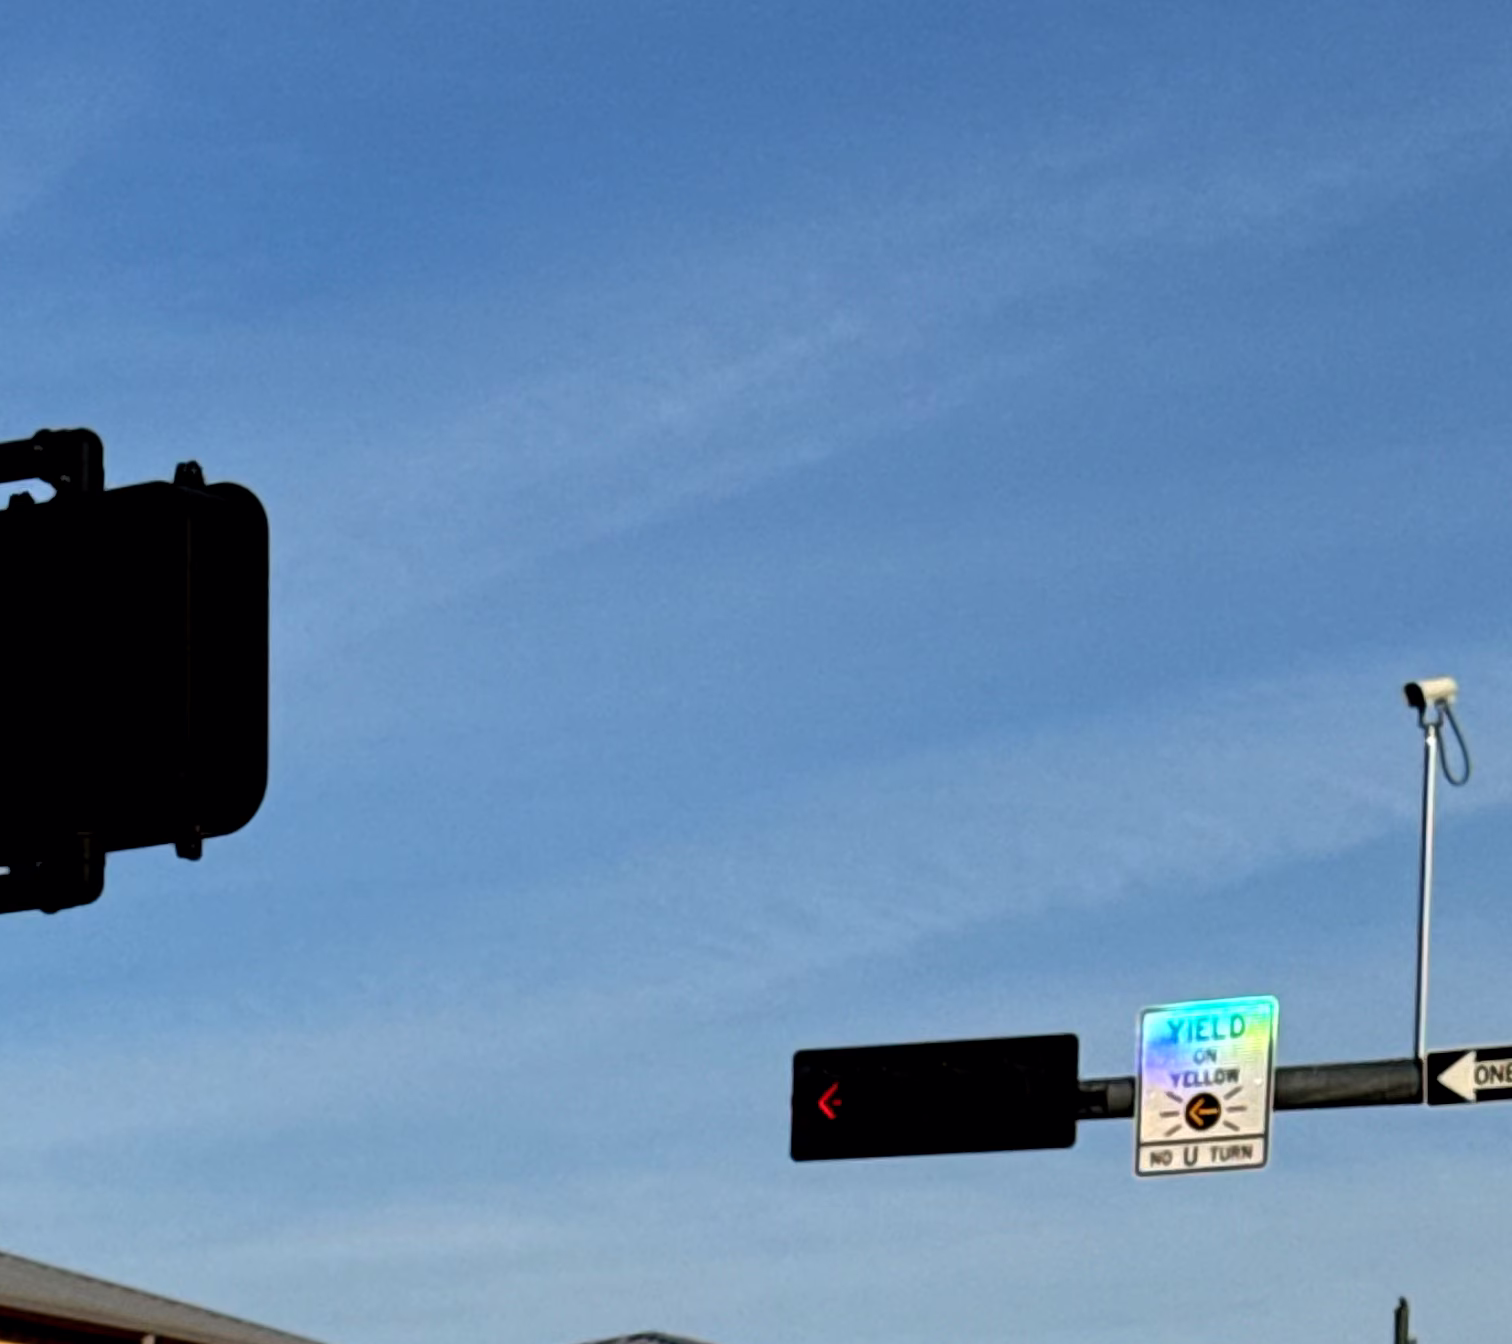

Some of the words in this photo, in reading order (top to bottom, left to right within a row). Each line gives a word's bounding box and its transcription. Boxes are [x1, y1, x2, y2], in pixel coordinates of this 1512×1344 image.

[1167, 1013, 1246, 1044] YIELD
[1193, 1049, 1218, 1065] ON
[1170, 1068, 1241, 1089] YELLOW
[1150, 1149, 1173, 1168] NO
[1183, 1145, 1199, 1167] U
[1210, 1144, 1254, 1164] TURN
